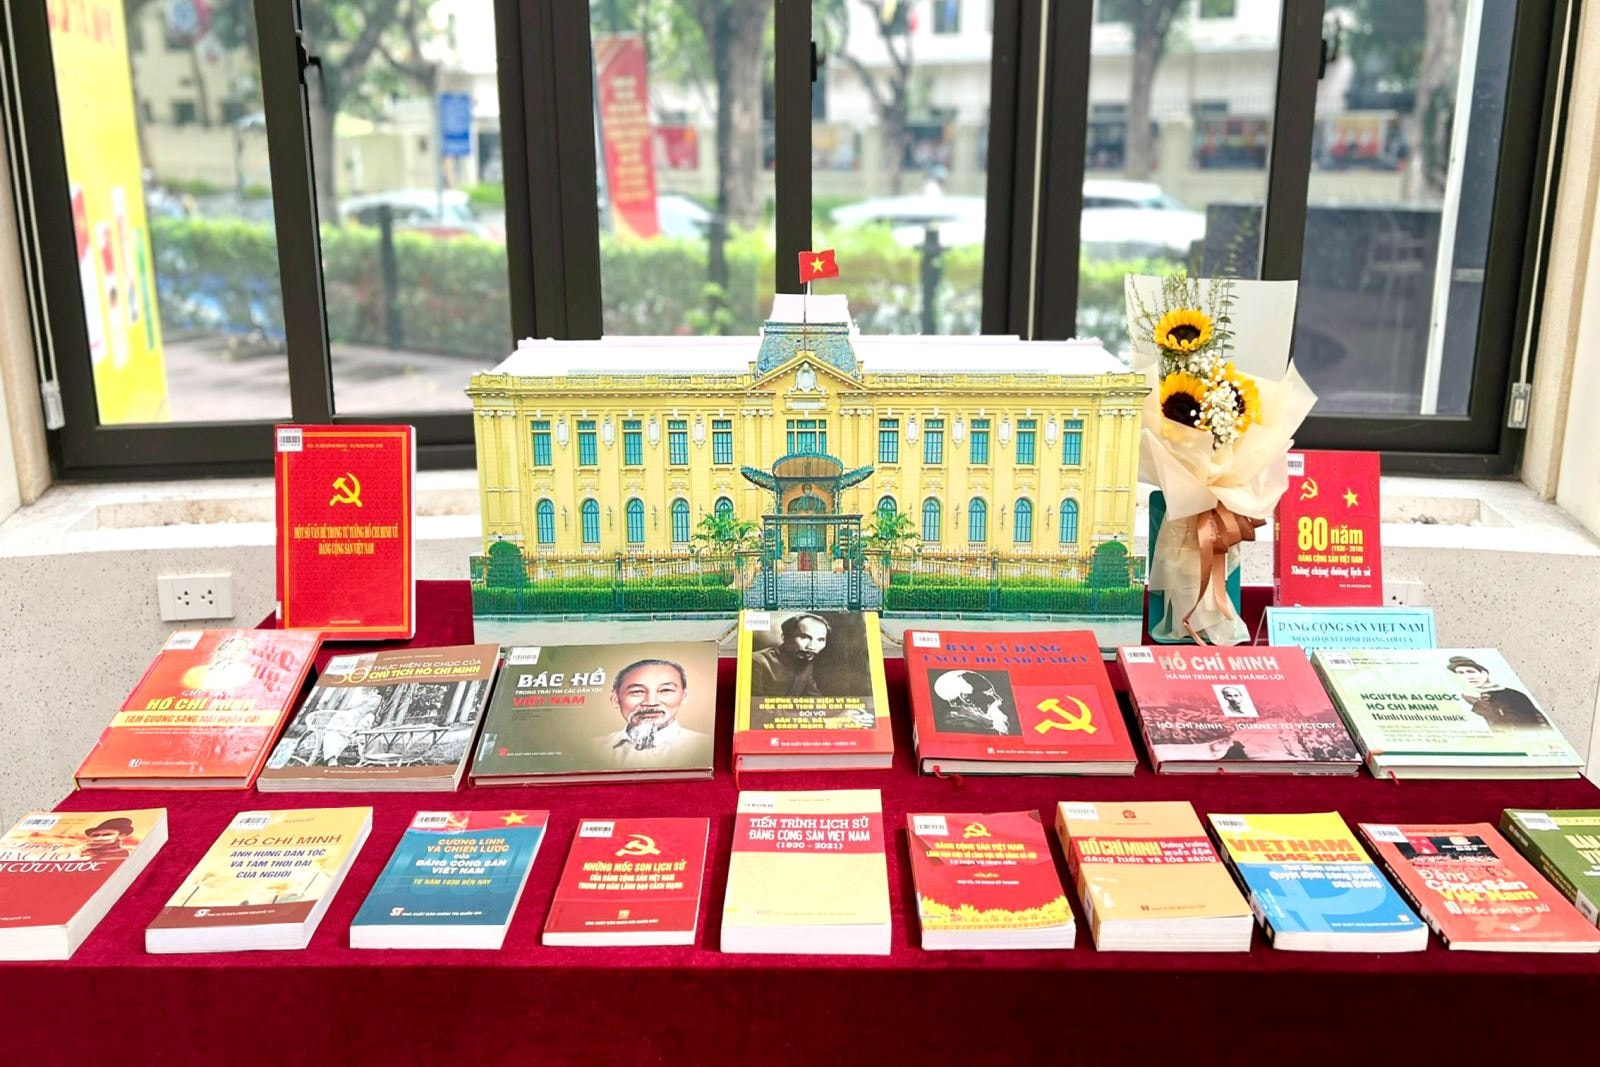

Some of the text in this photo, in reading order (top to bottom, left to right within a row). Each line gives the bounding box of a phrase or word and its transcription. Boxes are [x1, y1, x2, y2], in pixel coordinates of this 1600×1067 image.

[1298, 516, 1363, 551] 80 năm
[1399, 622, 1424, 633] NAM
[1158, 651, 1280, 671] HỒ CHÍ MINH
[517, 667, 606, 688] BÁC HỒ
[1194, 722, 1223, 730] MINH
[1234, 722, 1278, 730] JOURNEY
[1280, 722, 1294, 730] TO
[1295, 722, 1336, 730] VICTORY
[750, 816, 870, 830] TIẾN TRÌNH LỊCH SỬ
[230, 834, 342, 846] HỒ CHÍ MINH
[748, 828, 870, 842] ĐẢNG CỘNG SẢN VIỆT NAM
[1078, 838, 1163, 856] HỒ CHÍ MINH
[1287, 839, 1354, 852] NAM
[1264, 854, 1362, 862] 1945-1946
[583, 858, 687, 873] NHỮNG MỐC SON LỊCH SỬ
